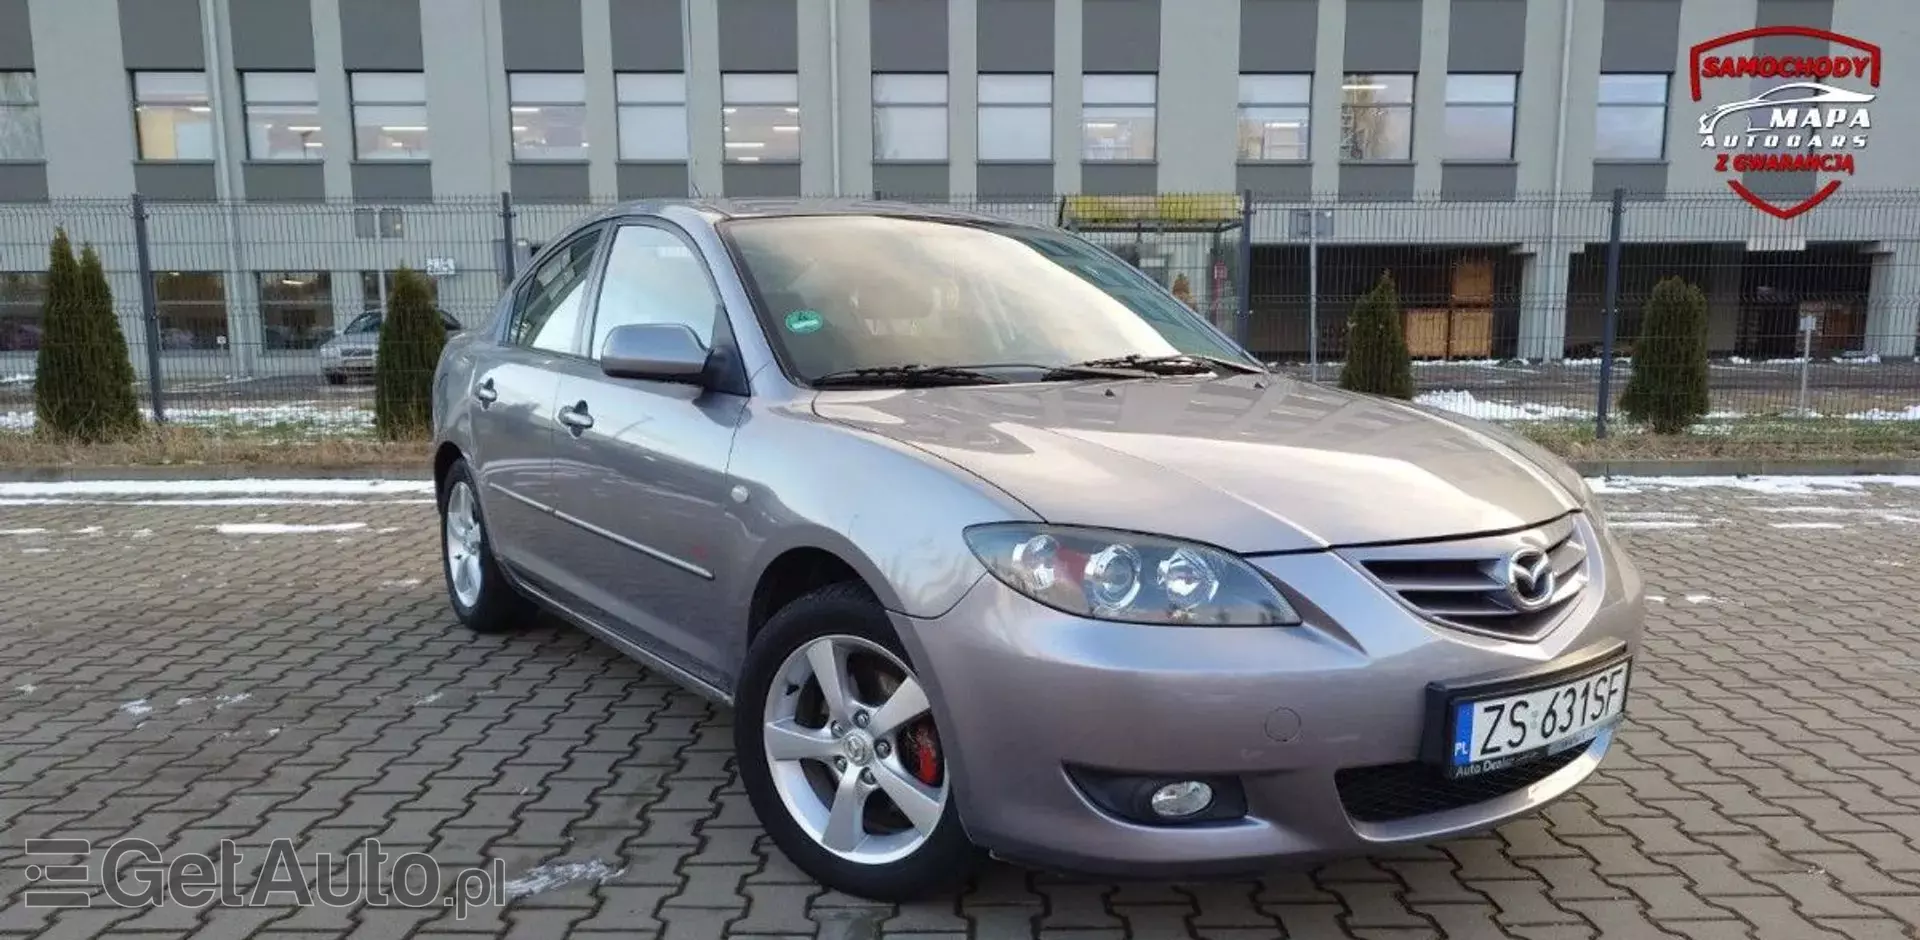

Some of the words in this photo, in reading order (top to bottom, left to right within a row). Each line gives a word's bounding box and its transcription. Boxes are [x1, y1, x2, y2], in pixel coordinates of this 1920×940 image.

[1480, 700, 1529, 755] ZS
[1541, 669, 1623, 738] 631SF
[1454, 741, 1468, 757] PL
[1456, 762, 1481, 777] Auto
